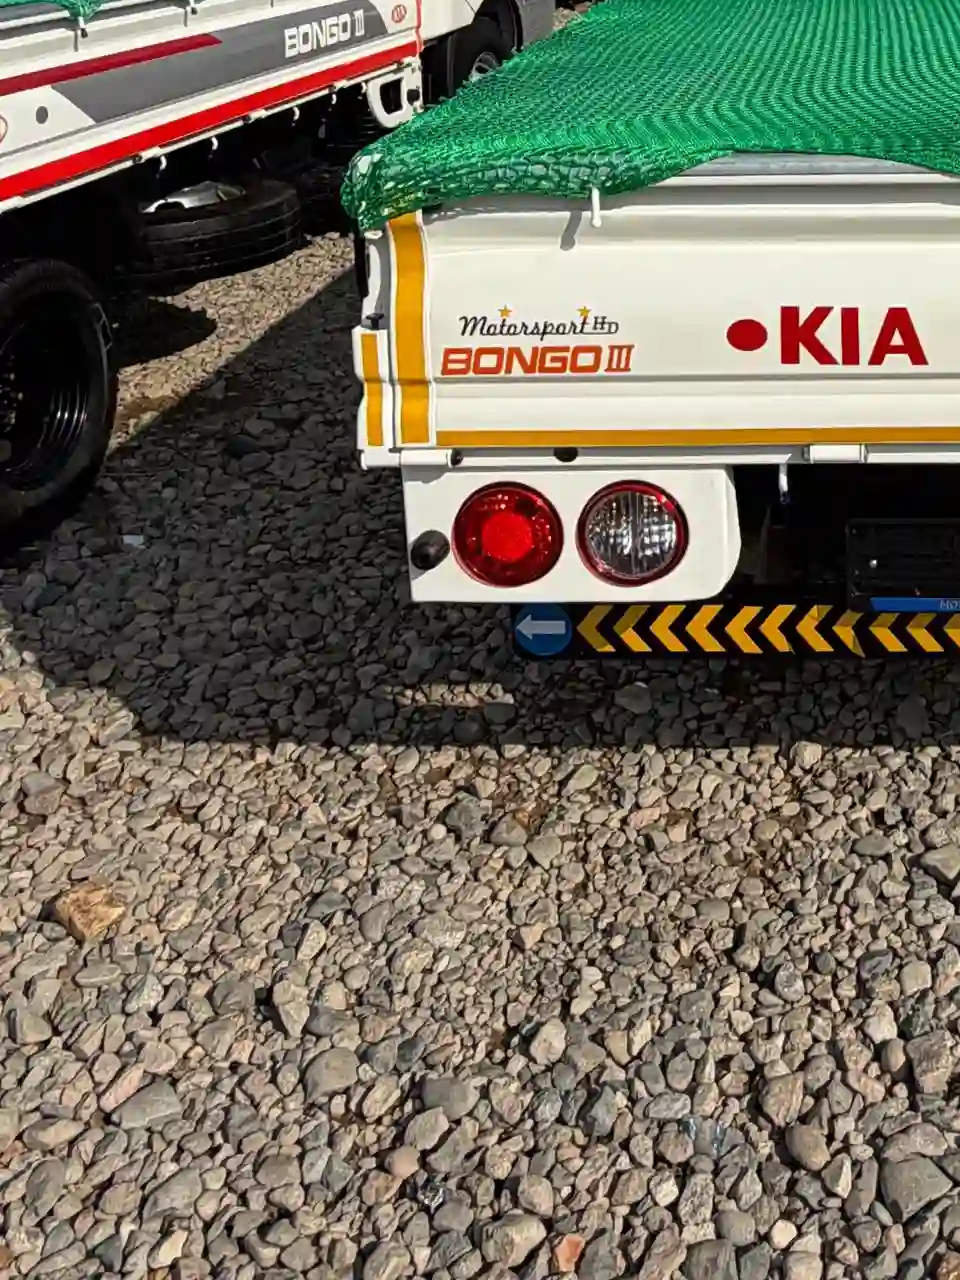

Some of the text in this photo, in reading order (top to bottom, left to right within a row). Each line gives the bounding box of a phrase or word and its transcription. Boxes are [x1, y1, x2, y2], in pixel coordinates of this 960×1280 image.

[284, 13, 352, 58] BONGO
[459, 315, 588, 341] Motorsport
[780, 306, 929, 366] KIA
[441, 344, 635, 375] BONGO III
